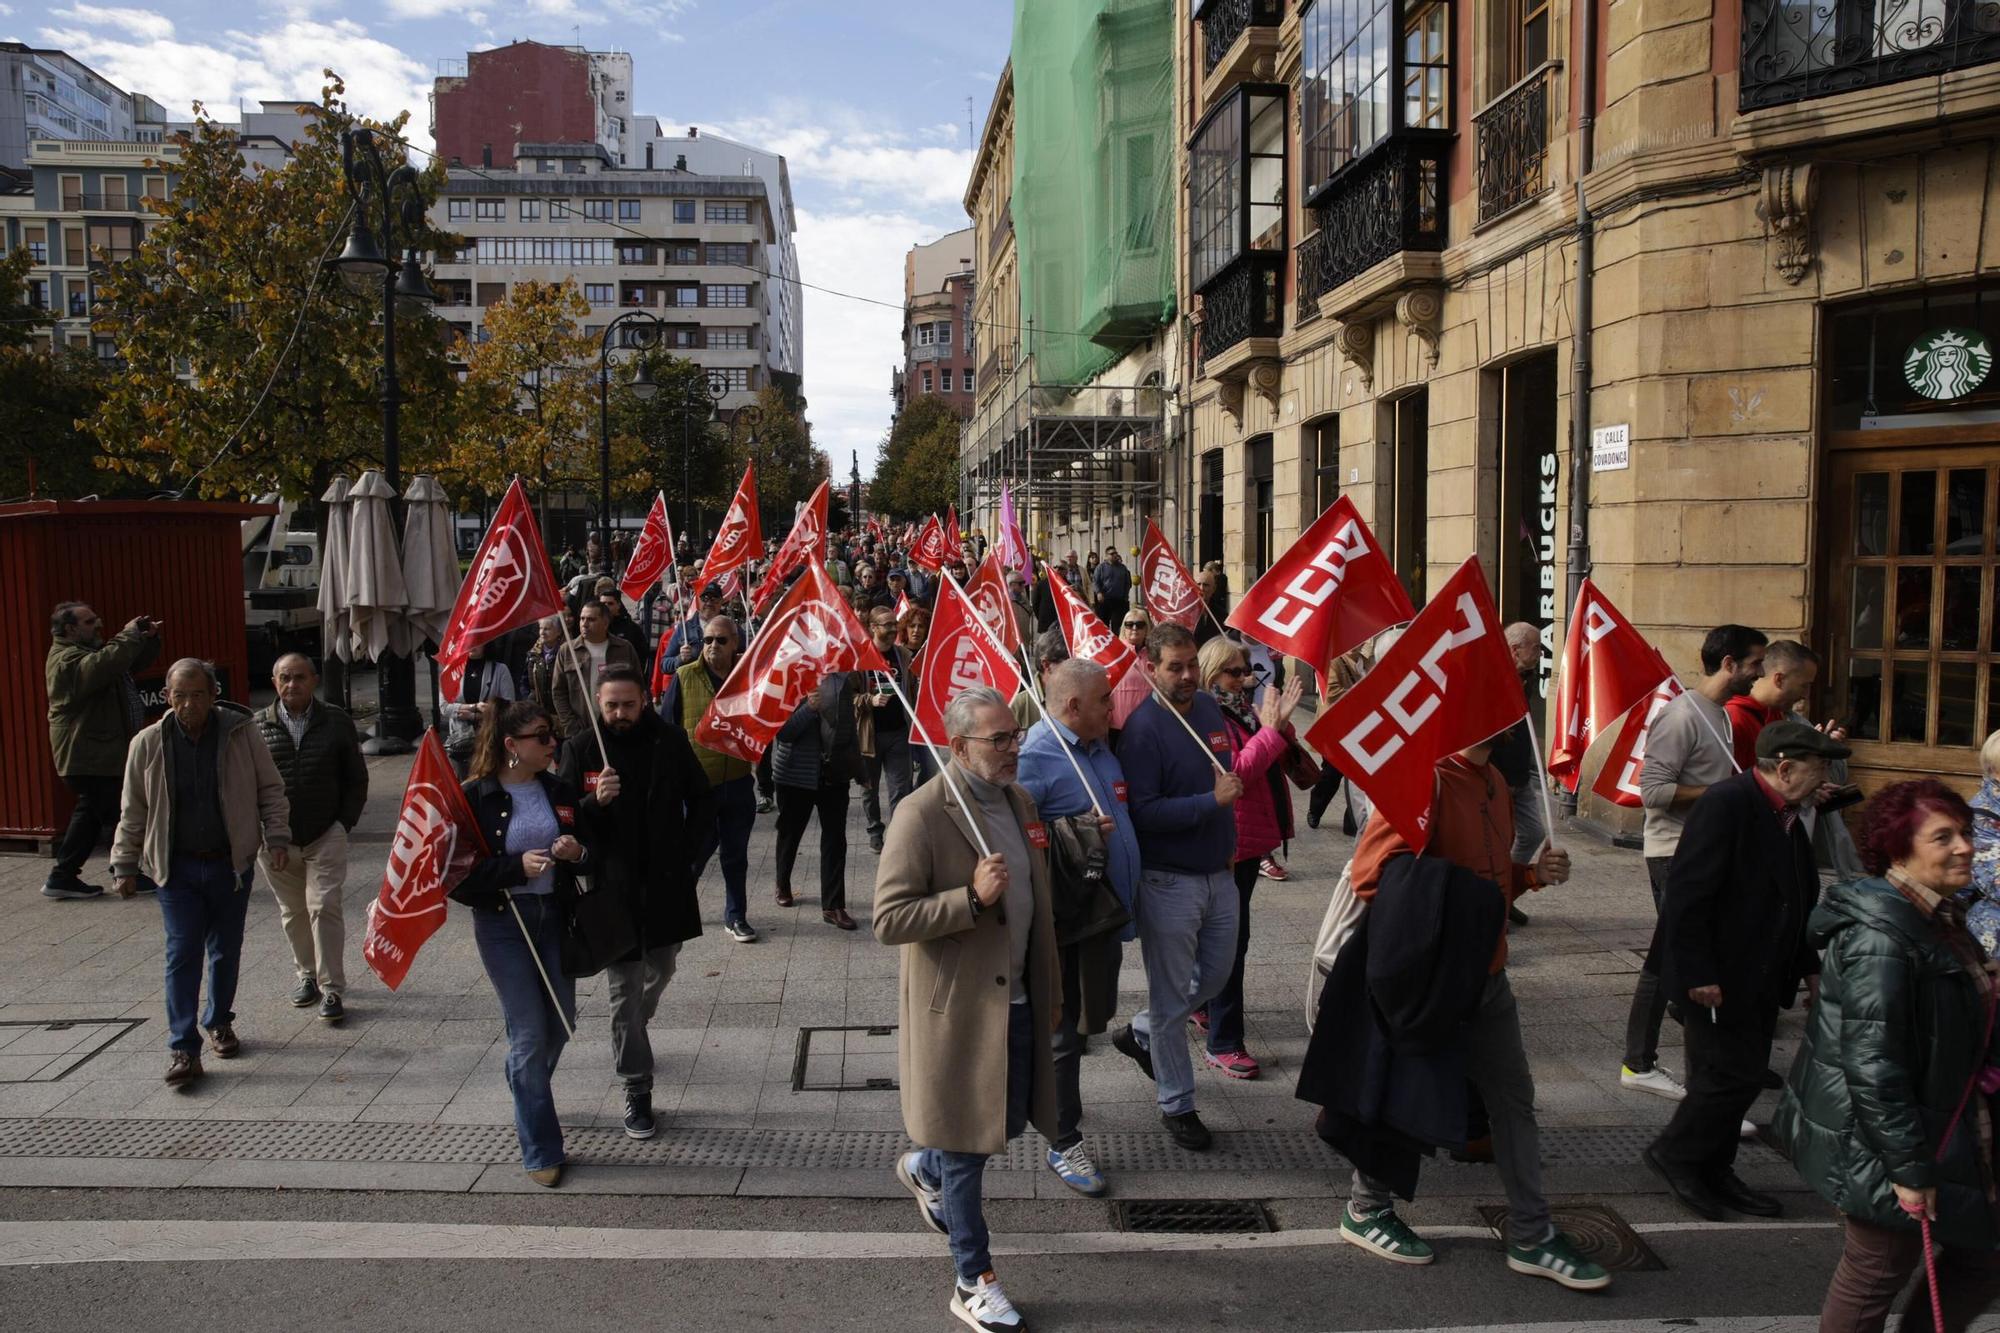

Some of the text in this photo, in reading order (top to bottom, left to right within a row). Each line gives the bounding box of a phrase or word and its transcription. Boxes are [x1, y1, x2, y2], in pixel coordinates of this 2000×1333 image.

[1605, 430, 1623, 444] CALLE
[1594, 451, 1627, 466] COVADONGA
[1538, 452, 1557, 700] STARBUCKS
